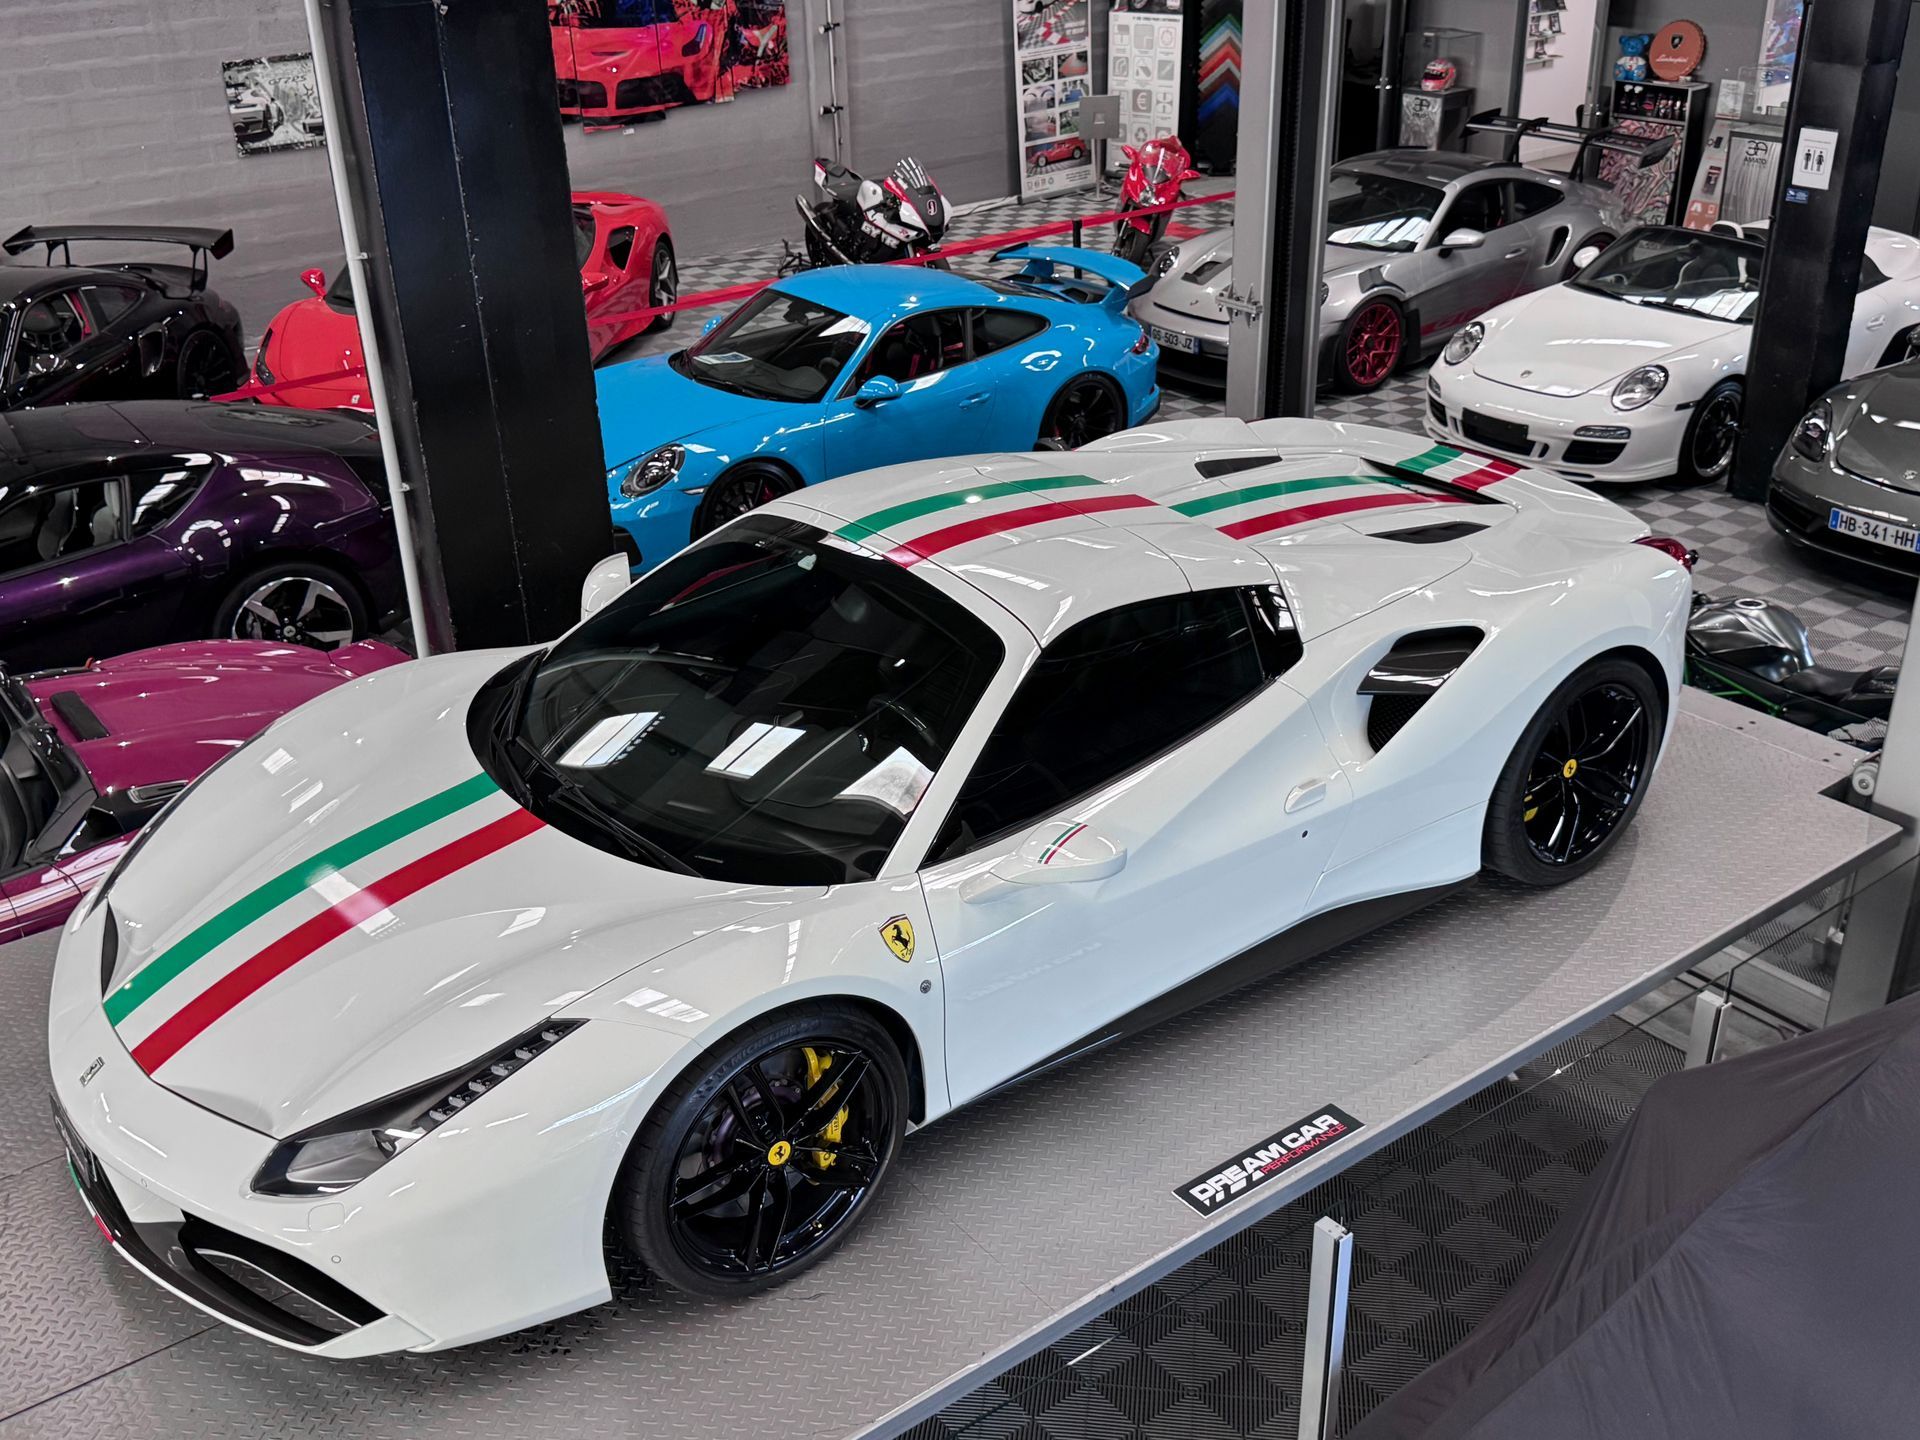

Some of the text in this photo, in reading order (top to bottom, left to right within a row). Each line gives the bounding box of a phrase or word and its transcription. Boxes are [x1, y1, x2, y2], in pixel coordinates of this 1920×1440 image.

[1839, 514, 1916, 549] HB-341-HH
[1189, 1114, 1341, 1206] DREAM CAR
[1261, 1123, 1348, 1175] PERFORMANCE
